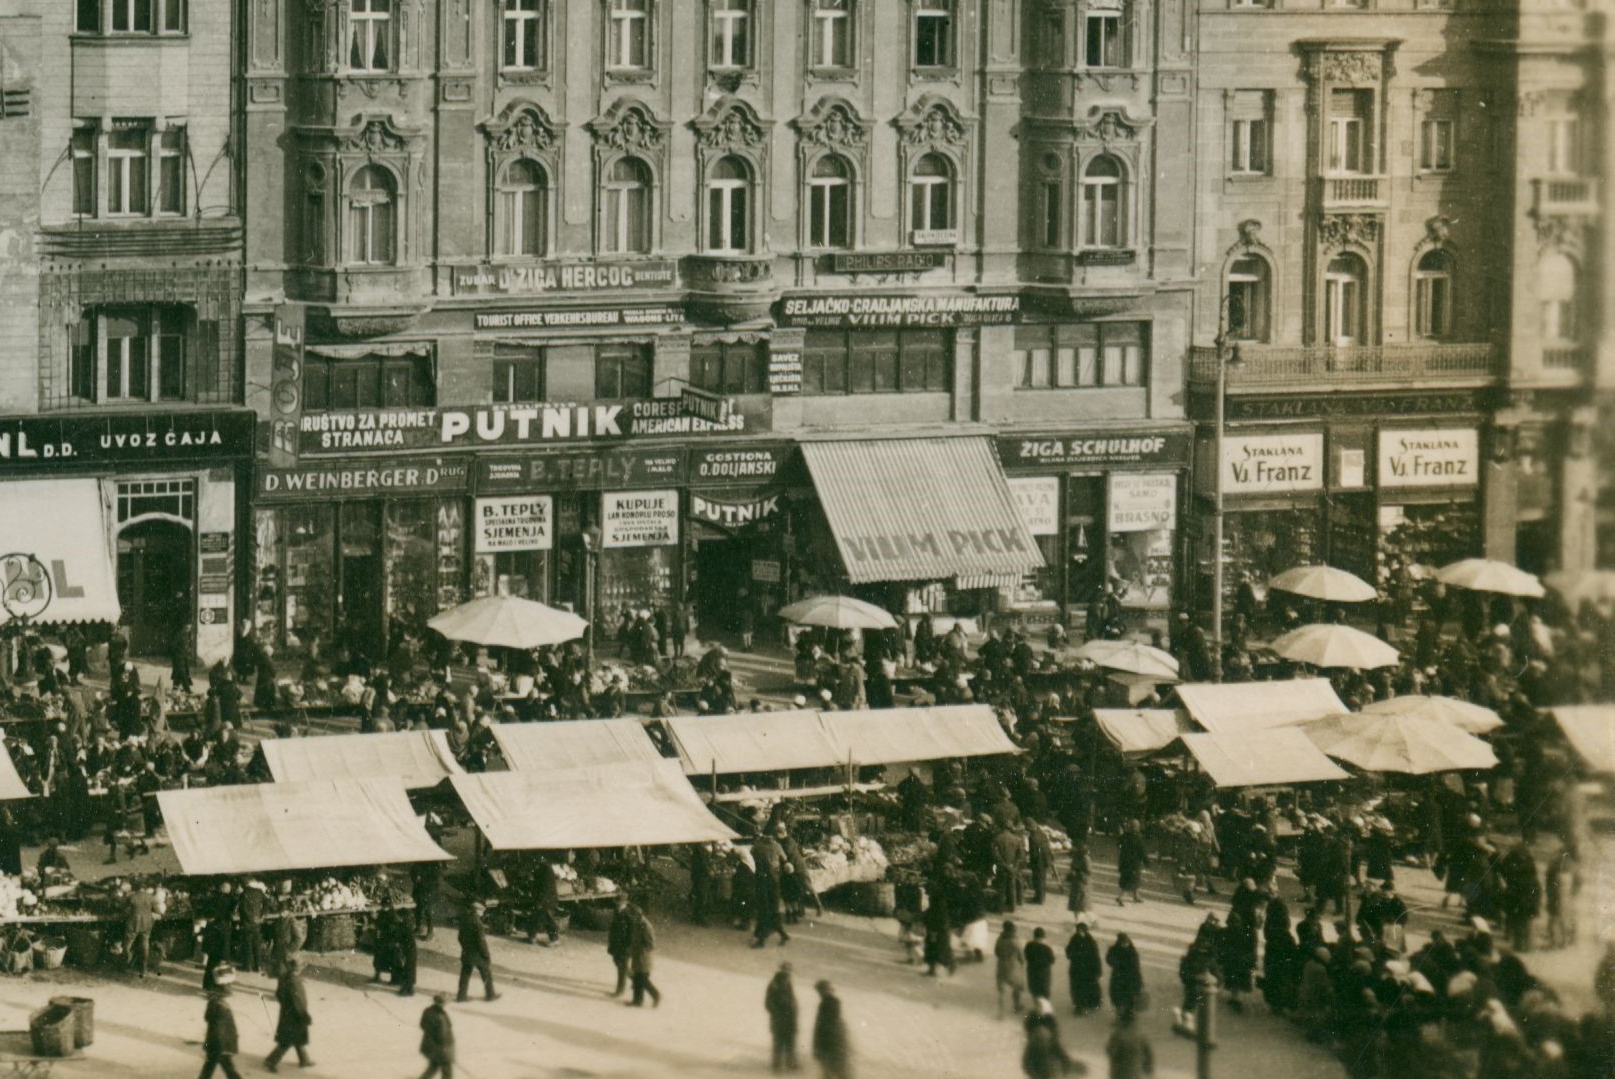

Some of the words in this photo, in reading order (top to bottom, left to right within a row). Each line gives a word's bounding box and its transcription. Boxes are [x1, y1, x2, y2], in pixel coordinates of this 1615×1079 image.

[846, 255, 891, 269] PHILIPS
[897, 254, 934, 267] RADIO
[936, 296, 1020, 312] MANUFAKTURA
[476, 314, 512, 327] TOURIST
[513, 313, 542, 326] OFFICE
[544, 311, 619, 325] VERKEHRSBUREAU
[848, 314, 902, 325] VILIM
[906, 312, 956, 325] PICK
[273, 319, 302, 454] BOJE
[682, 393, 717, 419] PUTNIK
[1241, 400, 1348, 416] STAKLANA
[1400, 395, 1476, 411] FRANZ
[321, 430, 404, 448] STRANACA
[631, 418, 690, 434] AMERICAN
[358, 414, 376, 430] ZA
[379, 411, 437, 429] PROMET
[441, 404, 623, 443] PUTNIK
[44, 443, 79, 458] D.D.
[100, 432, 157, 449] UVOZ
[165, 429, 223, 446] ČAJA
[1070, 437, 1166, 456] SCHULHOF
[1243, 443, 1304, 461] STAKLANA
[1399, 437, 1460, 453] STAKLANA
[705, 452, 773, 463] GOSTIONA
[1413, 455, 1469, 477] Franz
[530, 460, 554, 483] B.
[557, 456, 637, 481] TEPLY
[1256, 460, 1313, 483] Franz
[265, 473, 283, 492] D.
[286, 469, 419, 491] WEINBERGER
[483, 505, 499, 518] B.
[501, 502, 547, 517] TEPLY
[616, 498, 666, 510] KUPUJE
[693, 495, 780, 523] PUTNIK
[483, 525, 545, 539] SJEMENJA
[611, 531, 670, 543] SJEMENJA
[842, 533, 941, 562] VILIM
[946, 527, 1027, 556] PICK
